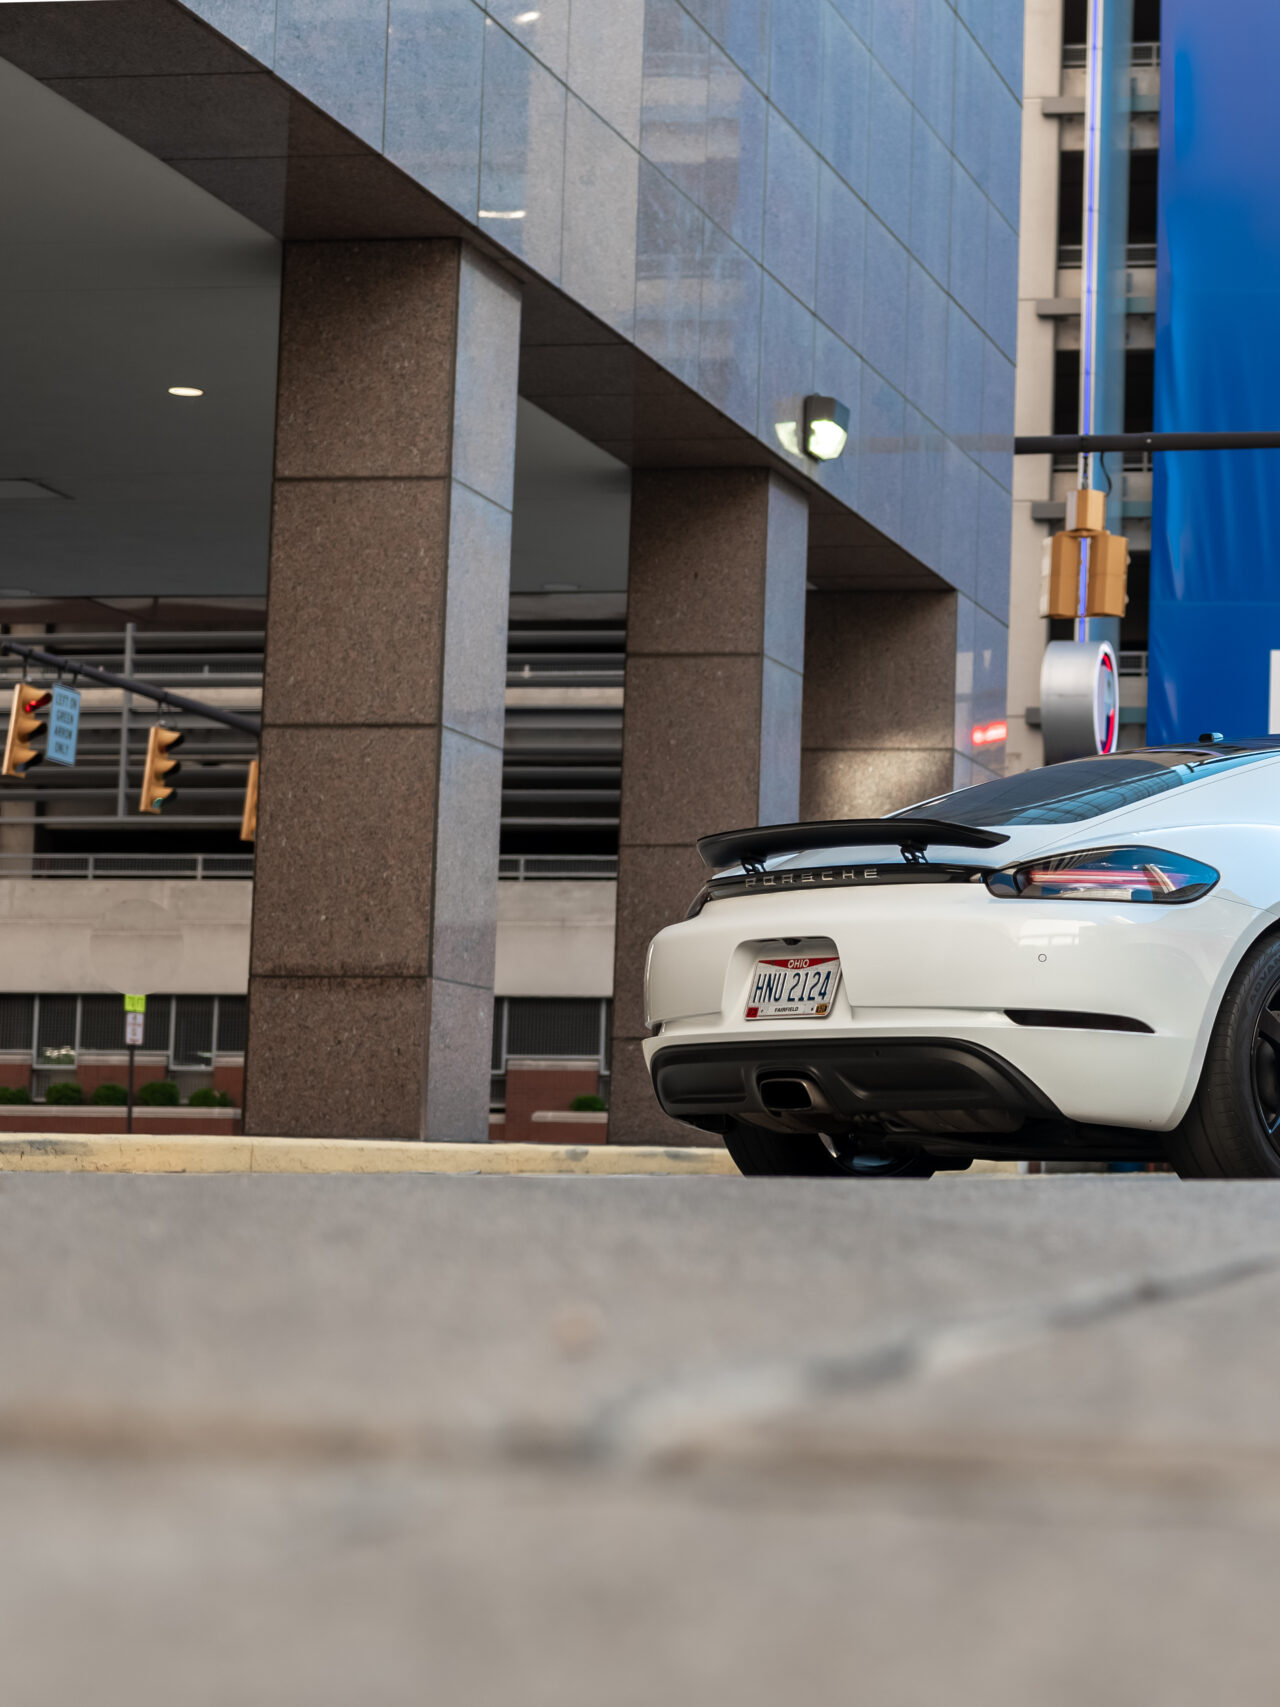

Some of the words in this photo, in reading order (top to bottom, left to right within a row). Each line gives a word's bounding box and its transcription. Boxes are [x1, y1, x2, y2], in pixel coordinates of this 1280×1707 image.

[745, 868, 879, 888] PORSCHE
[788, 959, 810, 969] OHIO
[752, 972, 788, 1004] HNU
[787, 970, 832, 1003] 2124
